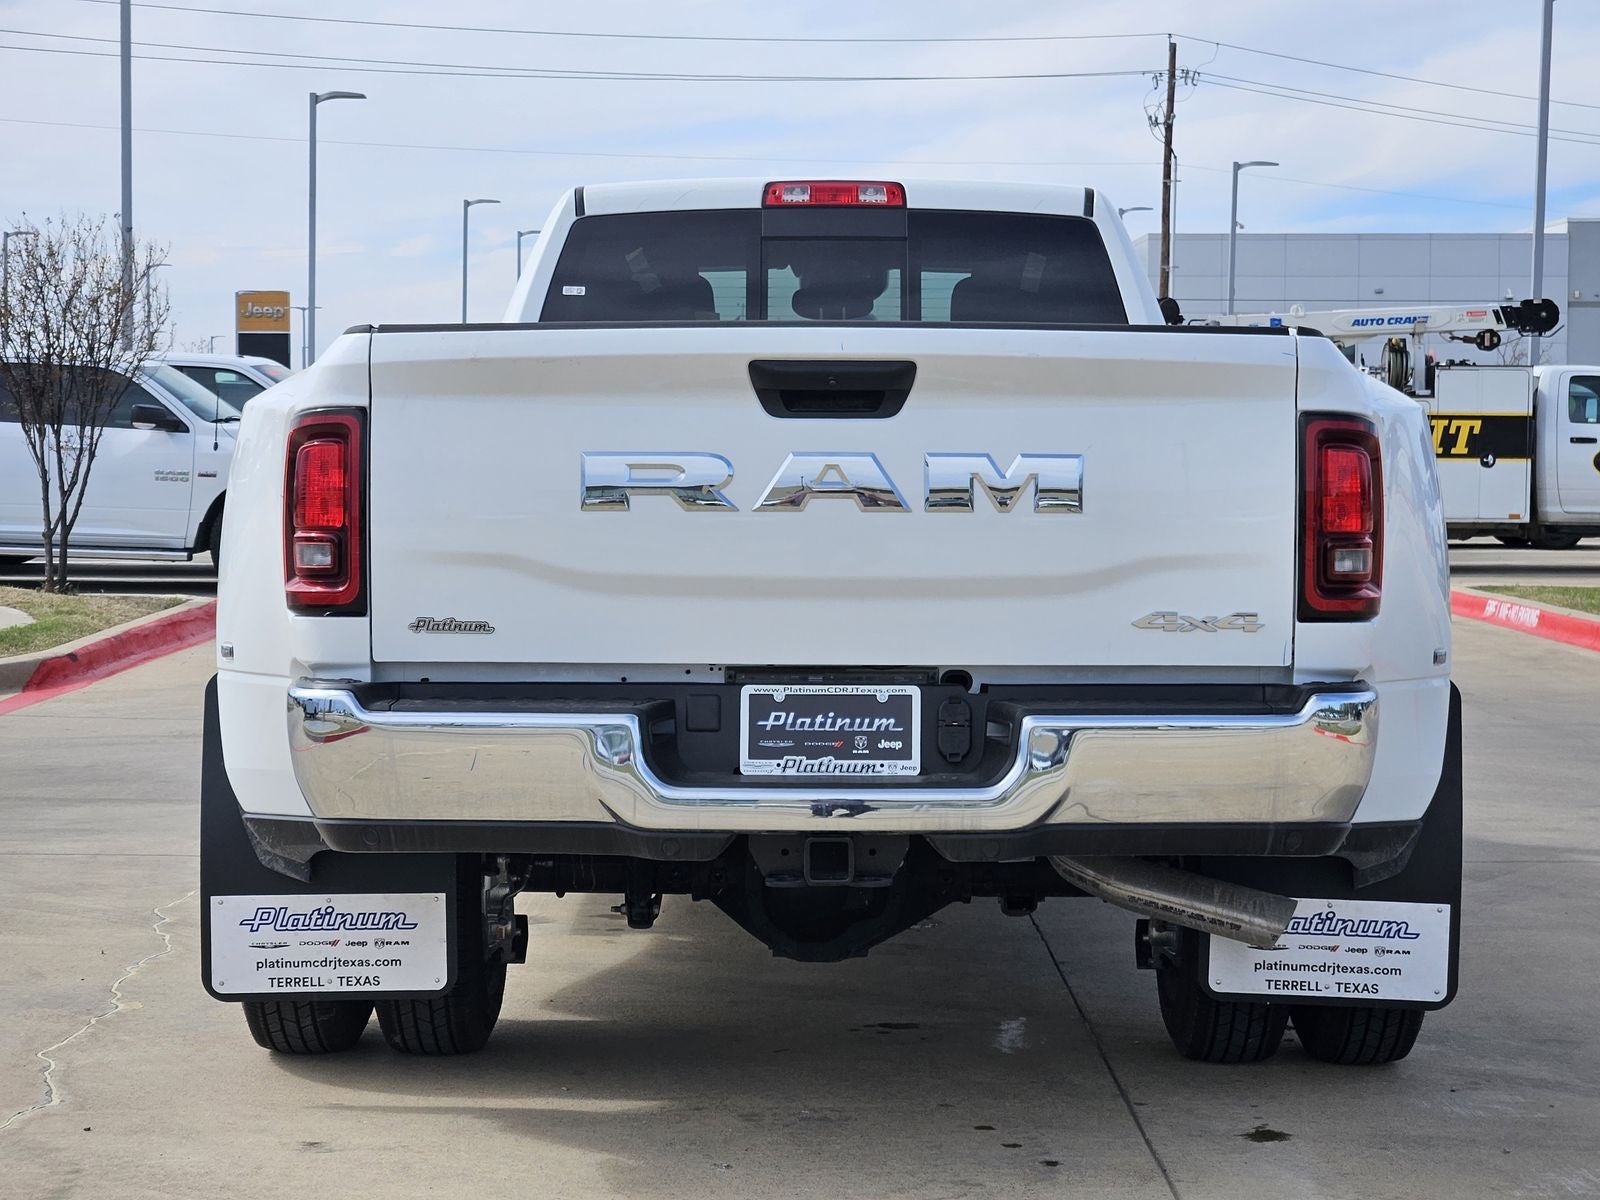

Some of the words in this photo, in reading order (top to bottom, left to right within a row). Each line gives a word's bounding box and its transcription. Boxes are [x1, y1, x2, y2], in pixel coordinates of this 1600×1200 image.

[241, 302, 284, 321] Jeep
[1352, 318, 1385, 327] AUTO
[581, 451, 1084, 513] RAM
[408, 616, 495, 634] Platinum
[753, 686, 907, 694] www.PlatinumCDRJTexas.com
[756, 711, 904, 732] Platinum
[877, 739, 903, 750] Jeep
[781, 757, 883, 775] Platinum
[239, 905, 419, 932] Platinum
[1282, 911, 1421, 940] atinum
[345, 940, 368, 948] Jeep
[1344, 946, 1368, 955] Jeep
[256, 957, 402, 971] platinumcdrjtexas.com
[1254, 960, 1402, 976] platinumcdrjtexas.com
[268, 977, 325, 988] TERRELL
[337, 976, 381, 987] TEXAS
[1265, 979, 1323, 992] TERRELL
[1335, 982, 1379, 994] TEXAS
